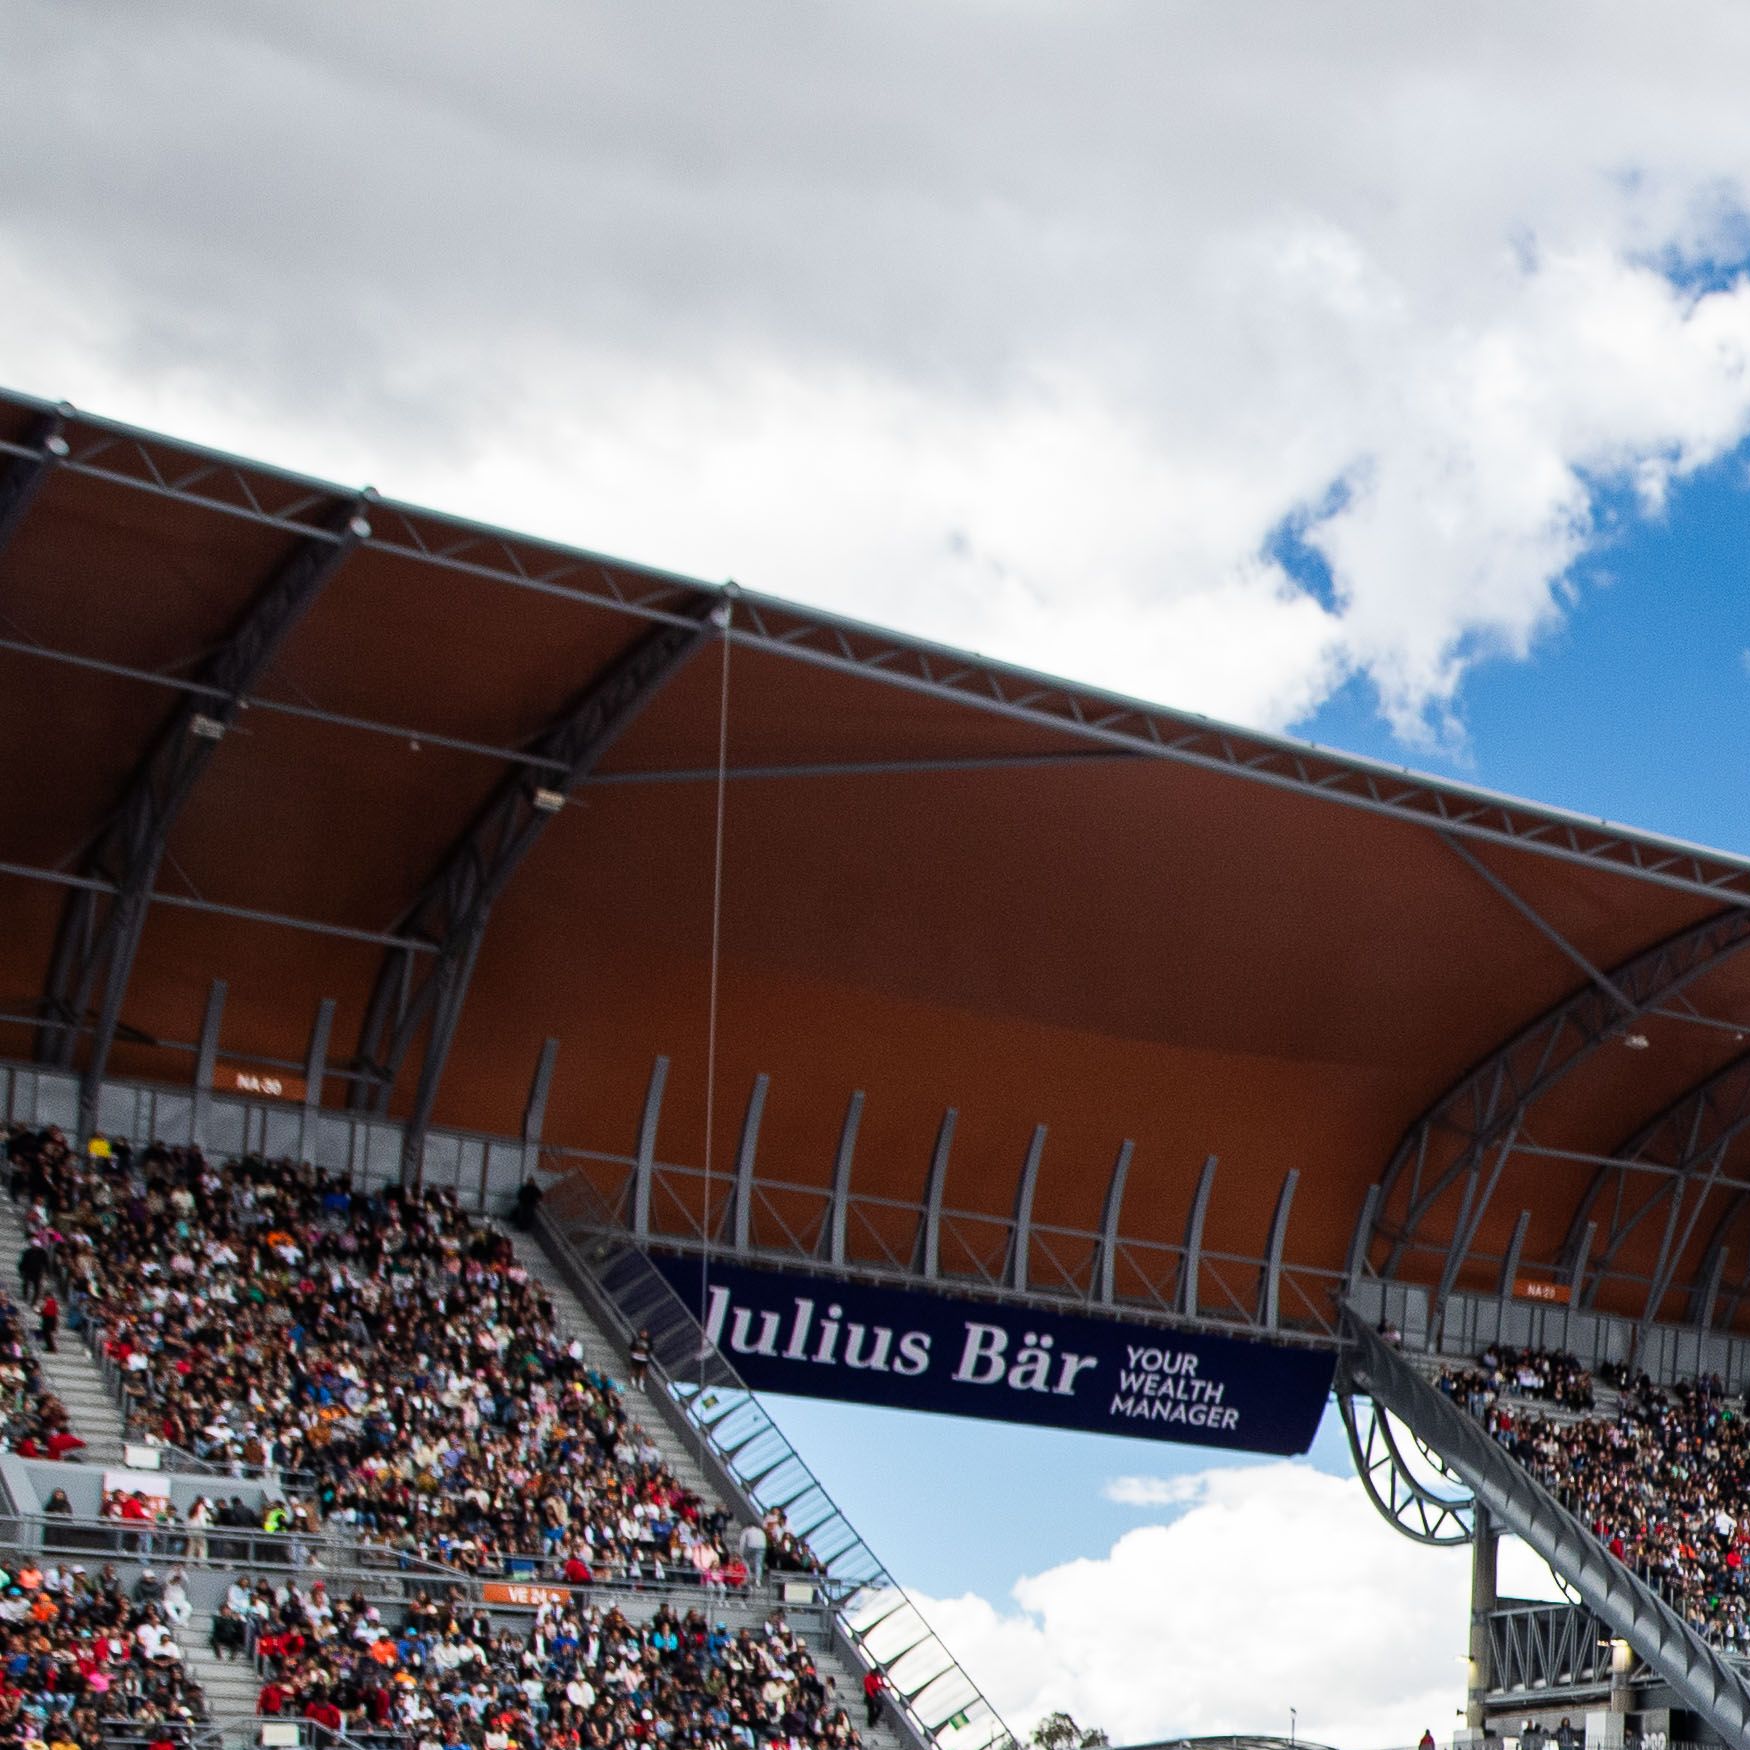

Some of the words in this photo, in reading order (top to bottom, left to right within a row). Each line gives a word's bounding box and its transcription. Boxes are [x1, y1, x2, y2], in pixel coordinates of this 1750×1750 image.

[695, 1284, 932, 1377] Julius
[952, 1320, 1099, 1396] Bär
[1125, 1344, 1199, 1377] YOUR
[1118, 1369, 1225, 1406] WEALTH
[1109, 1397, 1240, 1431] MANAGER
